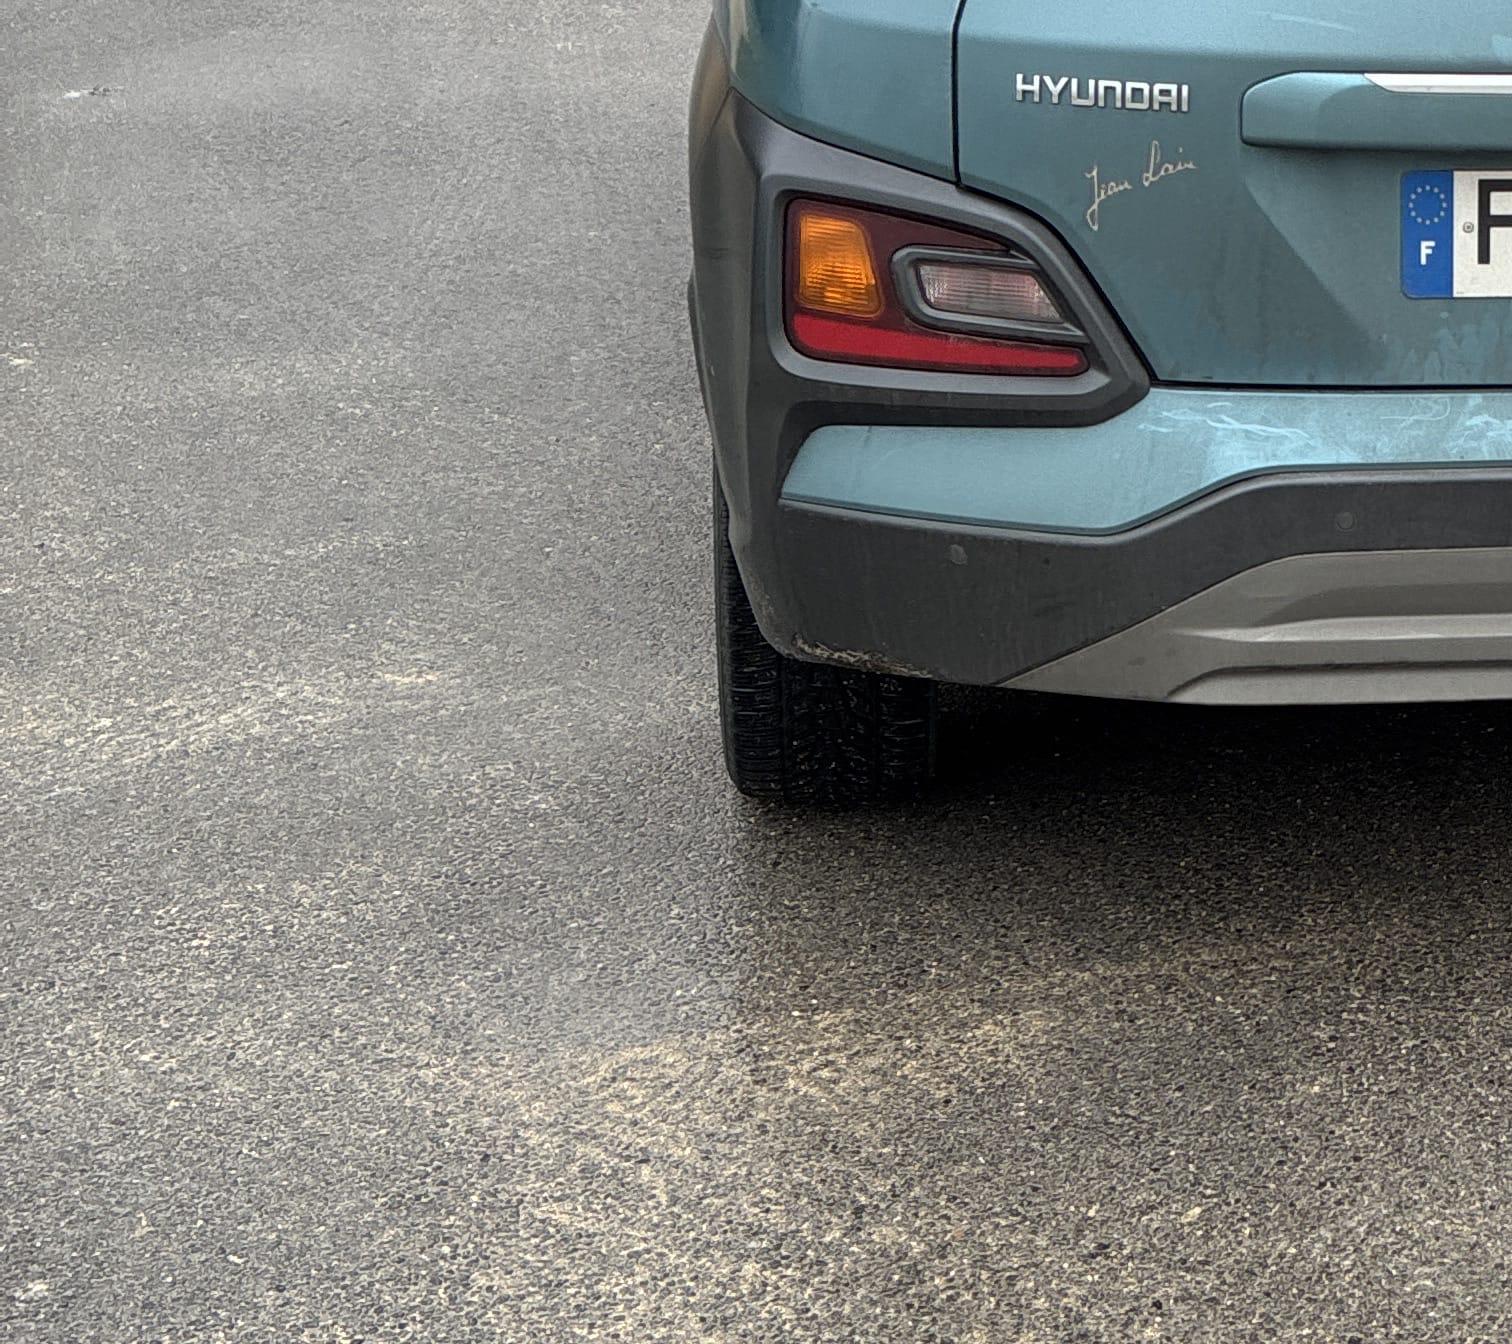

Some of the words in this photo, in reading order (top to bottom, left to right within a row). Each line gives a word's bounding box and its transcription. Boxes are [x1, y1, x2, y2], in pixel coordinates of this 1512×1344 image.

[1015, 73, 1190, 113] HYUNDAI
[1084, 164, 1133, 232] Jean
[1142, 140, 1197, 187] Lain
[1419, 240, 1436, 265] F
